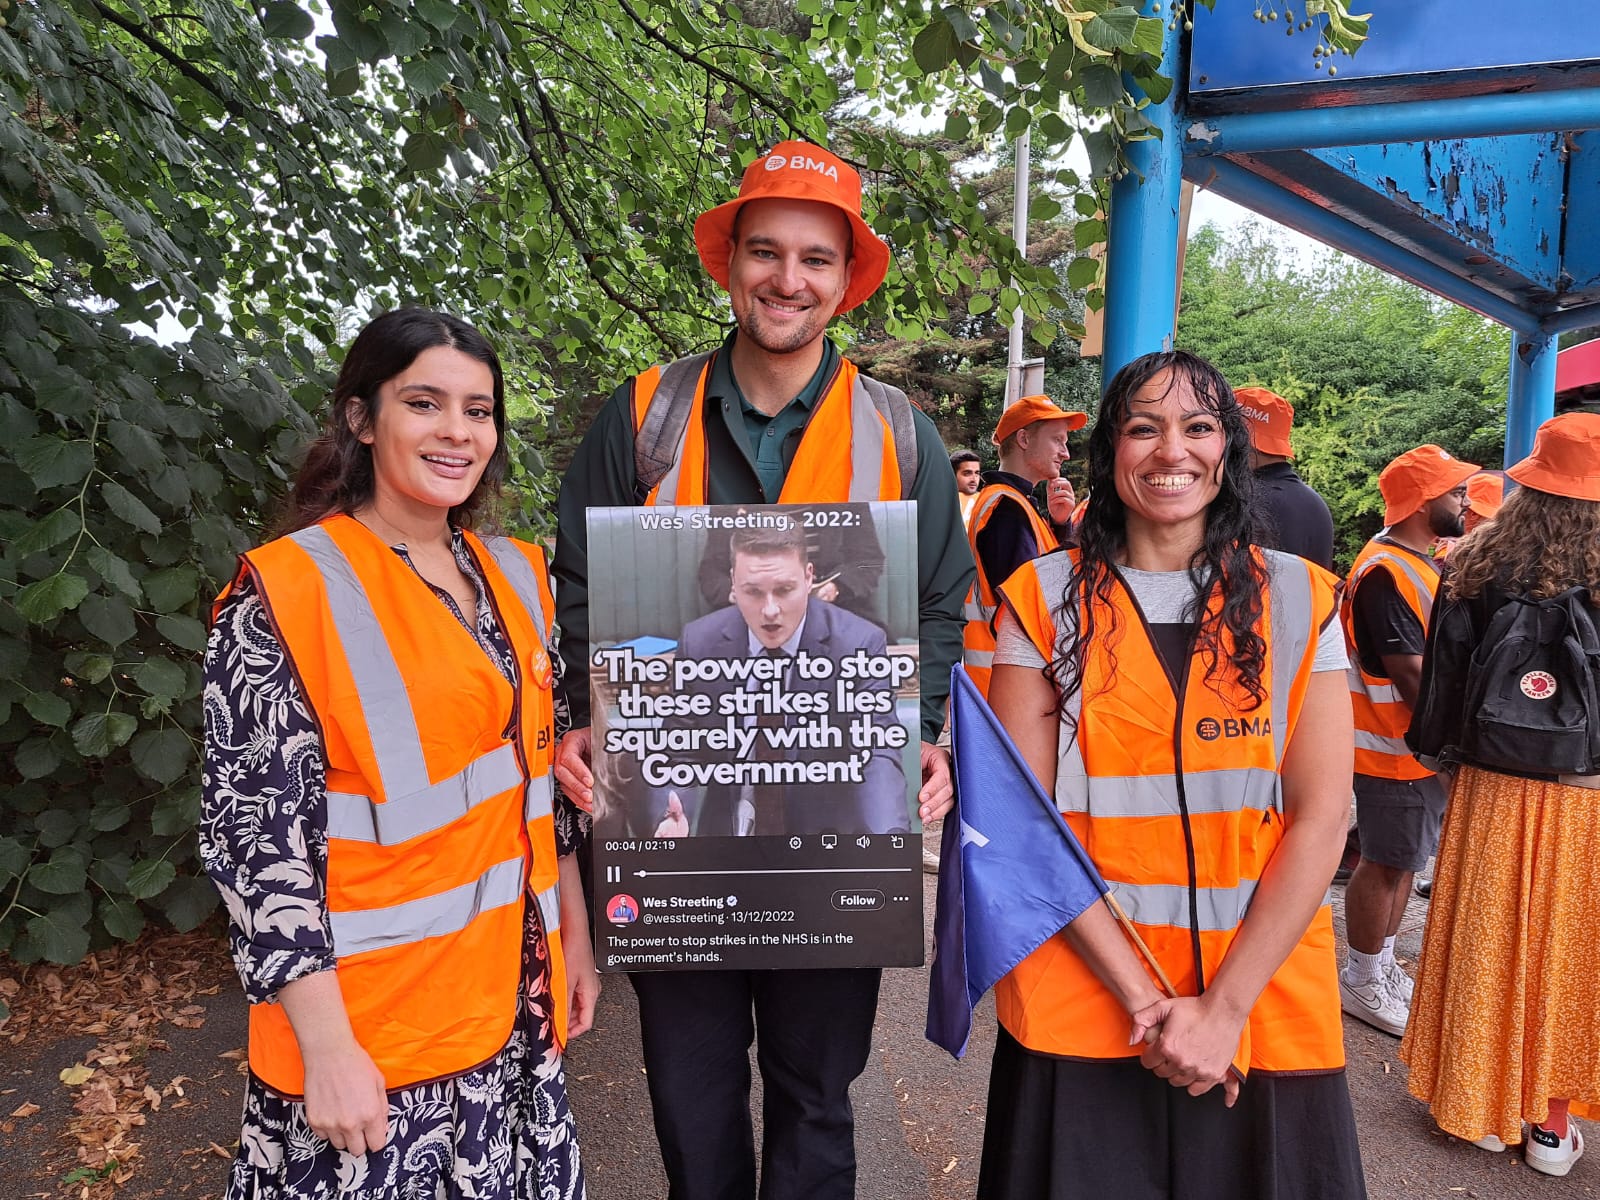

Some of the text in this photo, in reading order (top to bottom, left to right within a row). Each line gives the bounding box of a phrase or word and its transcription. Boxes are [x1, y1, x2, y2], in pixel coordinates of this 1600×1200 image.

[789, 155, 839, 183] BMA
[639, 511, 861, 532] Wes Streeting, 2022:
[674, 657, 792, 691] power
[796, 651, 834, 679] to
[839, 650, 915, 687] stop
[617, 679, 893, 717] these strikes lies
[1223, 717, 1271, 738] BMA
[605, 714, 908, 761] squarely with the
[605, 841, 636, 851] 00:04
[644, 840, 676, 850] 02:19
[642, 896, 725, 909] Wes Streeting
[840, 895, 876, 905] Follow
[643, 912, 725, 925] @wesstreeting
[731, 910, 795, 923] 13/12/2022
[607, 932, 854, 949] The power to stop strikes in the NHS is in the
[685, 951, 722, 962] hands.
